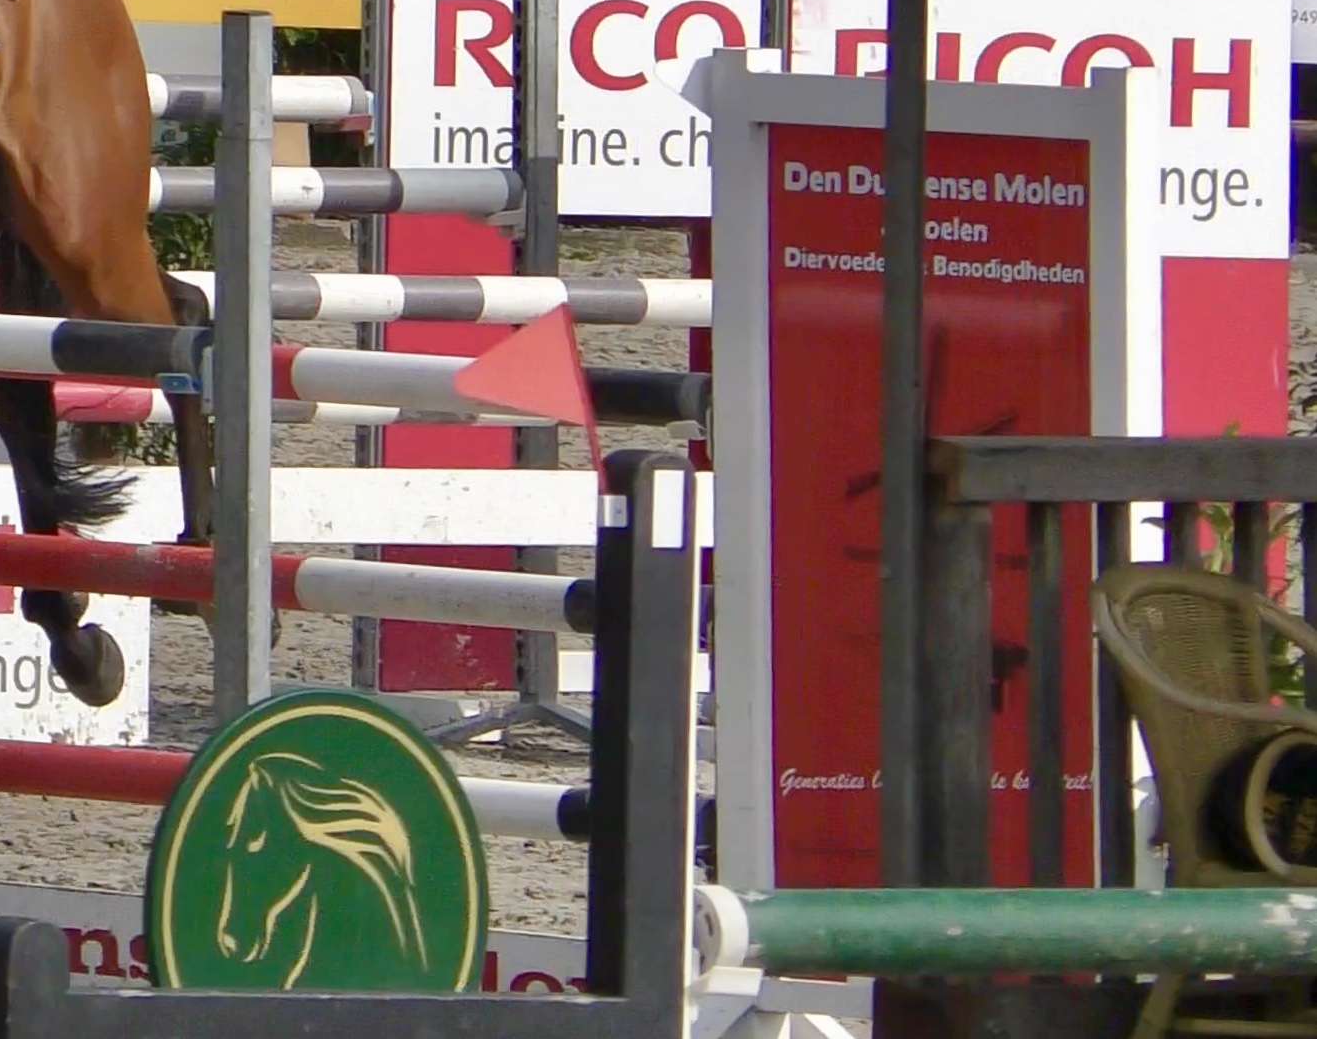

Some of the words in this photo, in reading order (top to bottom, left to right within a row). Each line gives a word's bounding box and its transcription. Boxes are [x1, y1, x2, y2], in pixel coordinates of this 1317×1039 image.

[433, 112, 640, 167] imaine.
[783, 161, 841, 193] Den
[847, 165, 988, 202] Duense
[994, 173, 1085, 206] Molen
[924, 217, 989, 243] oelen
[933, 255, 1085, 284] Benodigdheden
